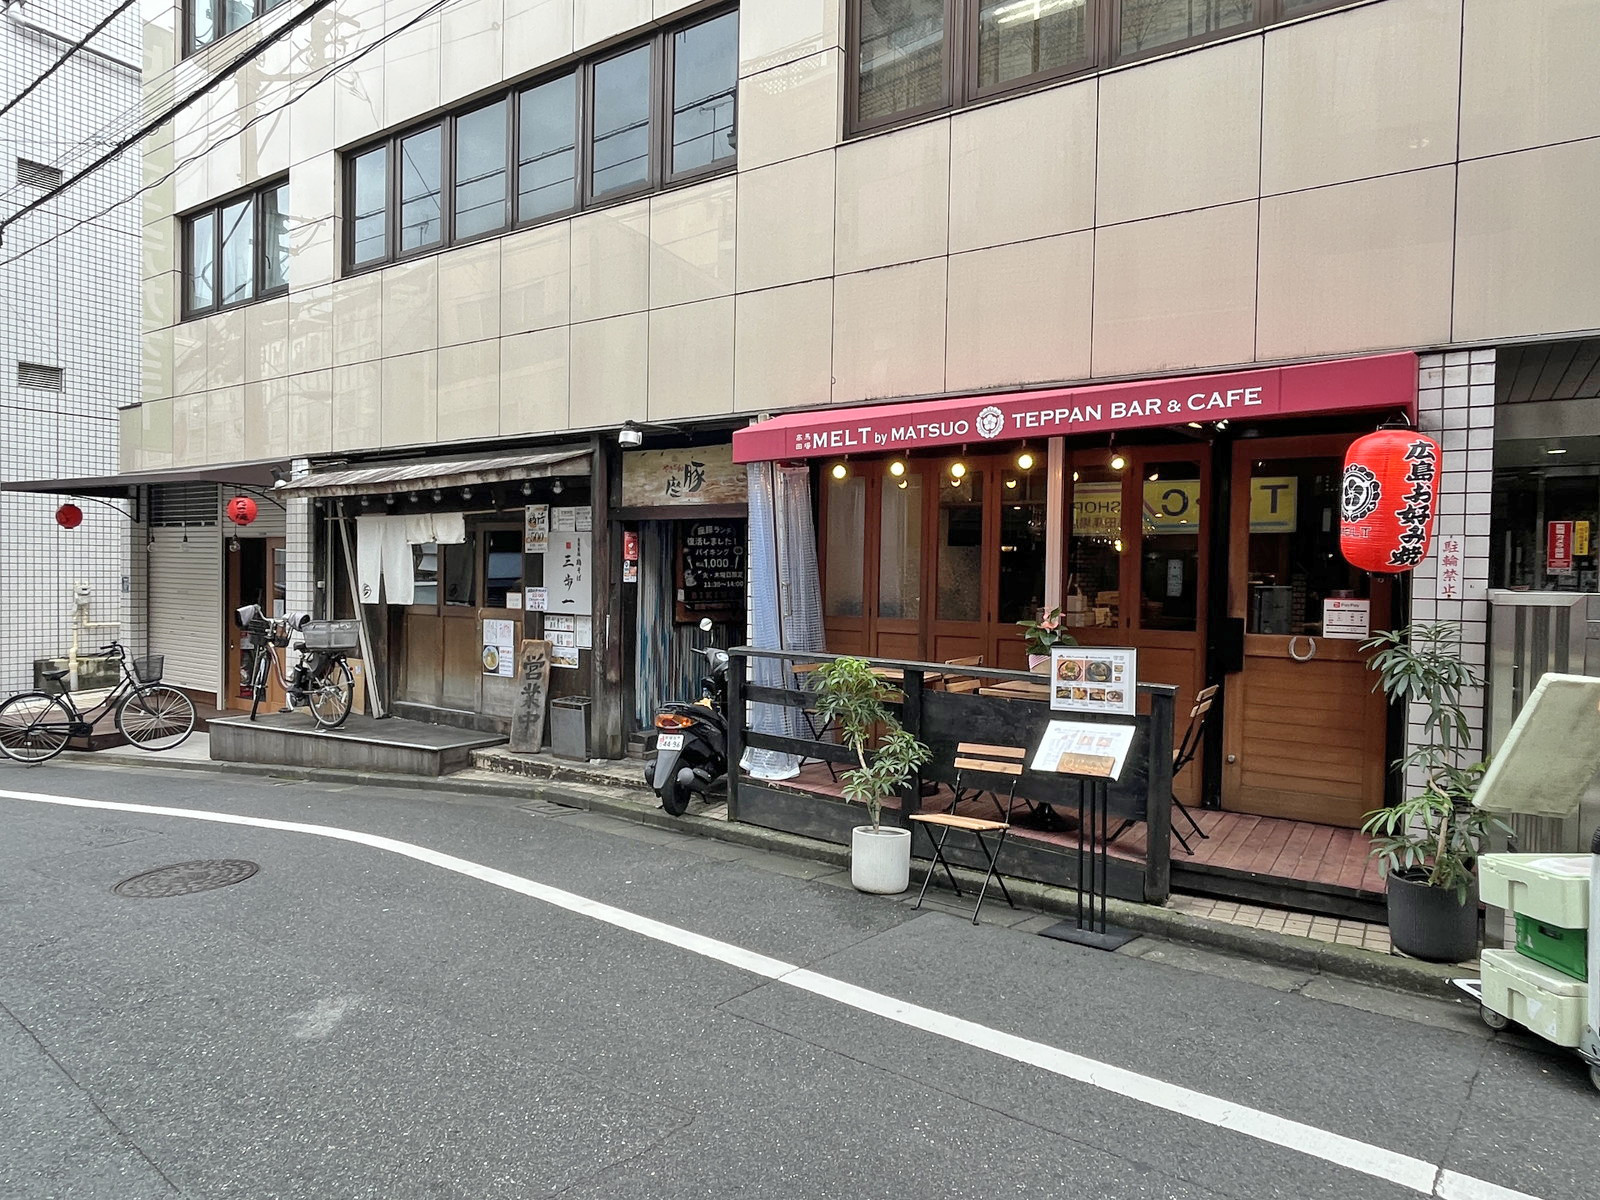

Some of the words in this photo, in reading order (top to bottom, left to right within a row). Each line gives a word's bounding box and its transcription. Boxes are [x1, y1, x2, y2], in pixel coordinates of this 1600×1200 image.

[1011, 404, 1103, 429] TEPPAN
[1110, 398, 1162, 419] BAR
[1166, 399, 1182, 413] &
[1187, 386, 1263, 412] CAFE
[812, 427, 872, 449] MELT
[874, 431, 888, 446] by
[890, 420, 969, 442] MATSUO
[1387, 439, 1437, 567] 広島お好み焼
[1341, 526, 1372, 539] ELT
[561, 554, 575, 604] 三歩一
[703, 558, 729, 568] 1,000
[1441, 540, 1460, 595] 駐輪禁止
[517, 653, 546, 734] 営業中
